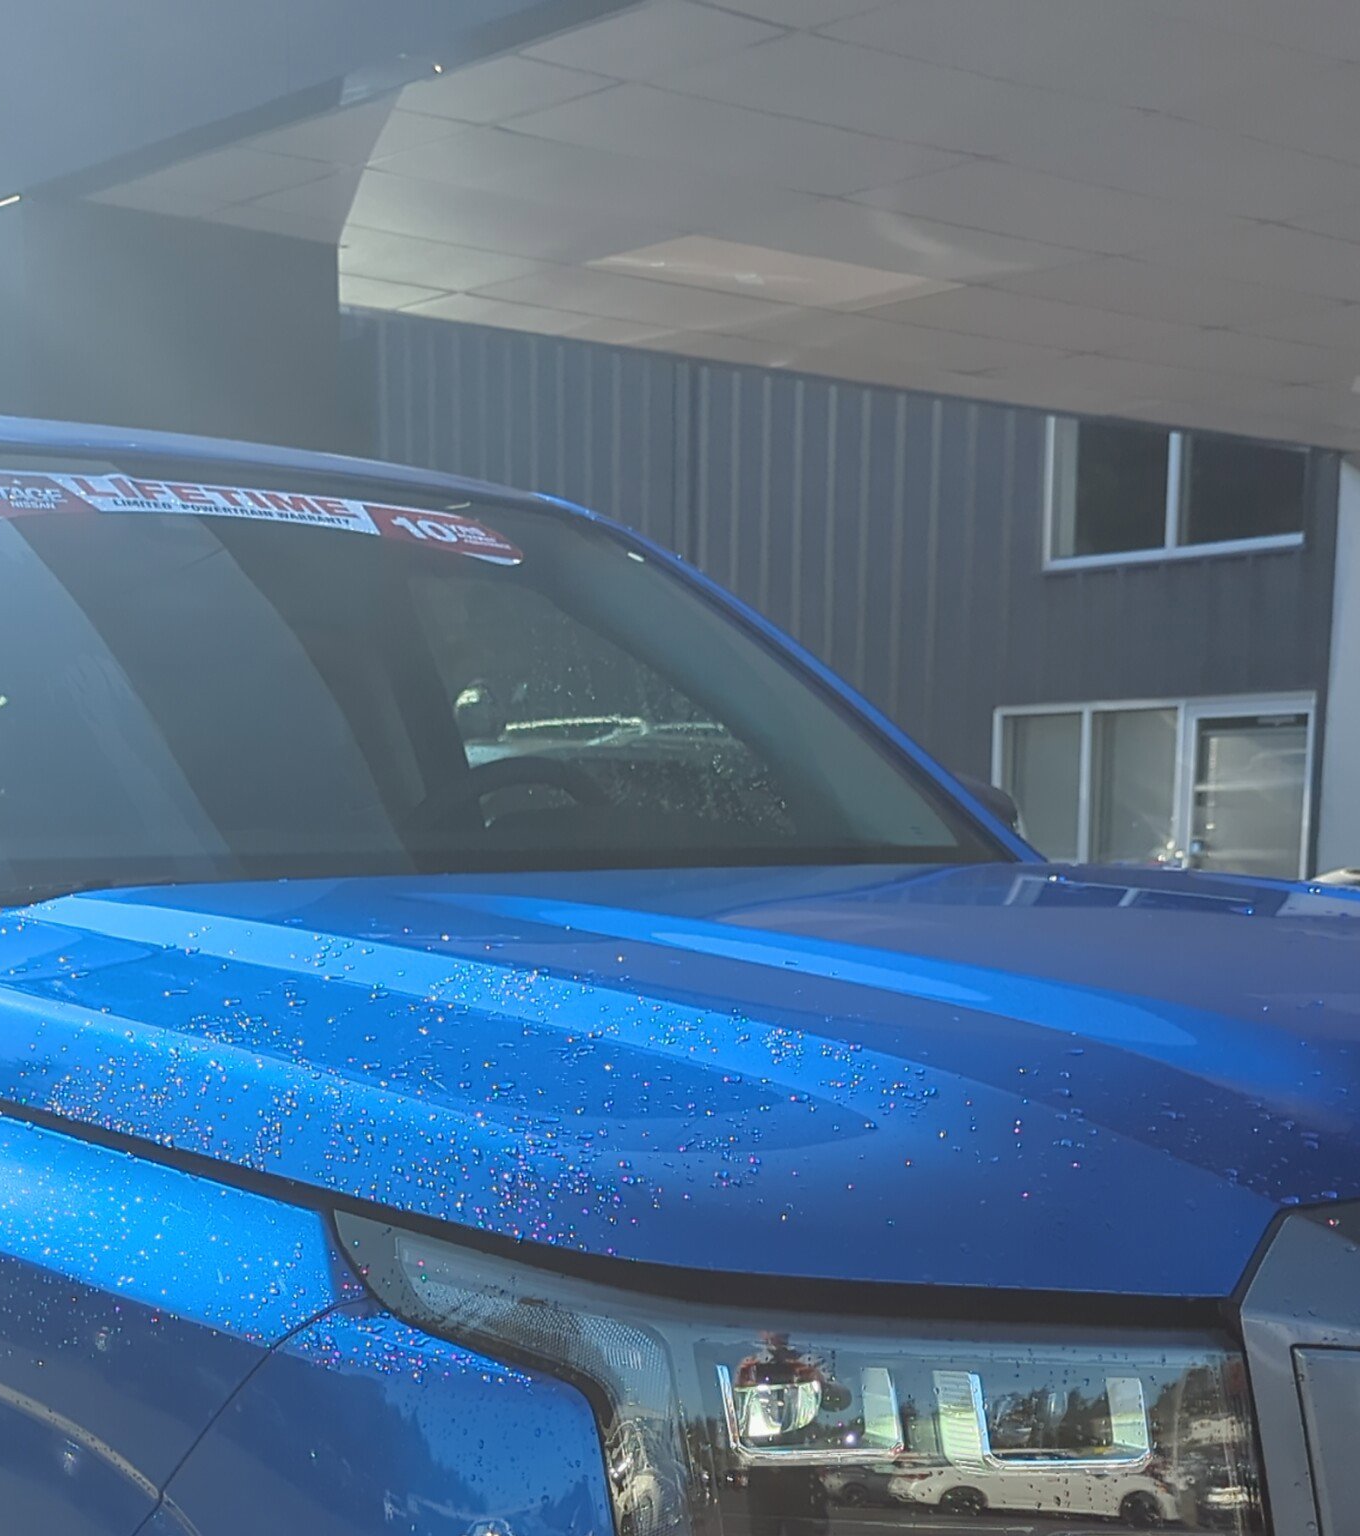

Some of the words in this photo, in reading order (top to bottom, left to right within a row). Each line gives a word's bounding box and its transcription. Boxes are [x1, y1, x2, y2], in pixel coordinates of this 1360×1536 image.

[9, 501, 57, 510] NISSAN
[70, 476, 360, 520] LIFETIME
[112, 498, 172, 511] LIMITED
[180, 503, 274, 519] POWERTRAIN
[275, 510, 351, 526] WARRANTY
[390, 515, 458, 543] 10
